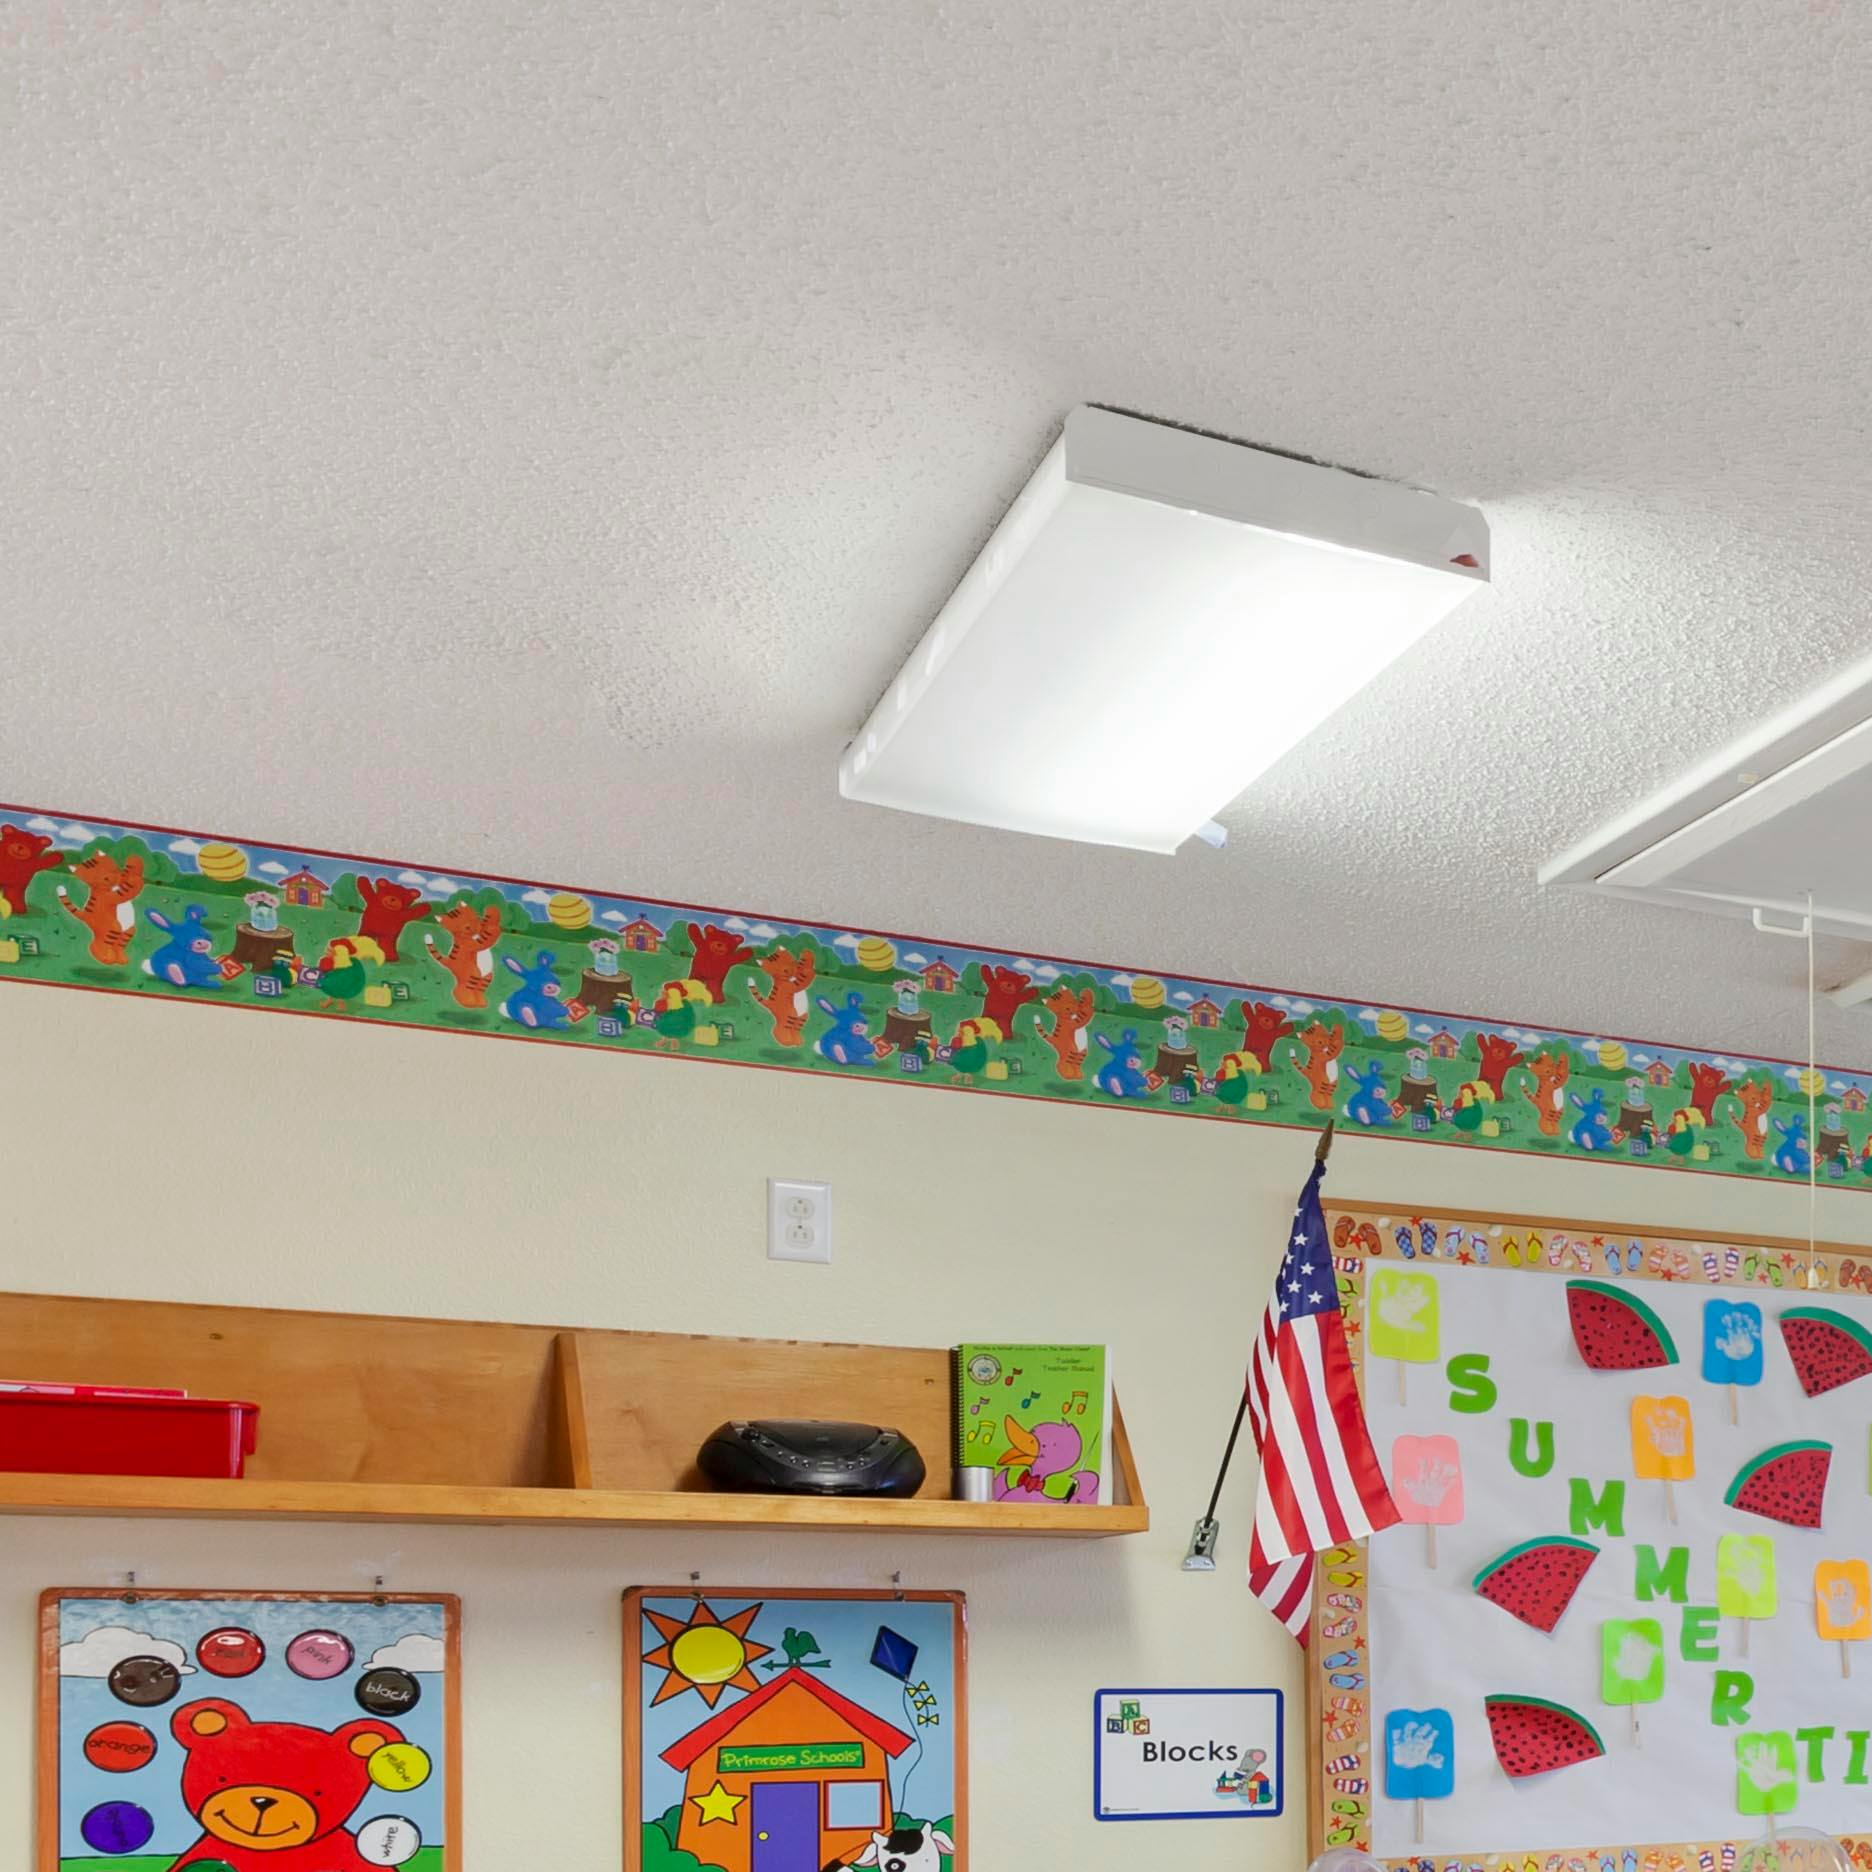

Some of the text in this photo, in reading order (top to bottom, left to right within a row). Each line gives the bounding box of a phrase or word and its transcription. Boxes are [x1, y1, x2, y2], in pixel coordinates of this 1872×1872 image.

[1446, 1353, 1755, 1727] SUMMER
[302, 1646, 334, 1666] pink
[365, 1682, 411, 1702] black
[88, 1739, 150, 1755] orange
[1143, 1740, 1238, 1762] Blocks
[381, 1752, 413, 1783] yellow
[721, 1752, 796, 1768] Primrose
[382, 1826, 400, 1858] white
